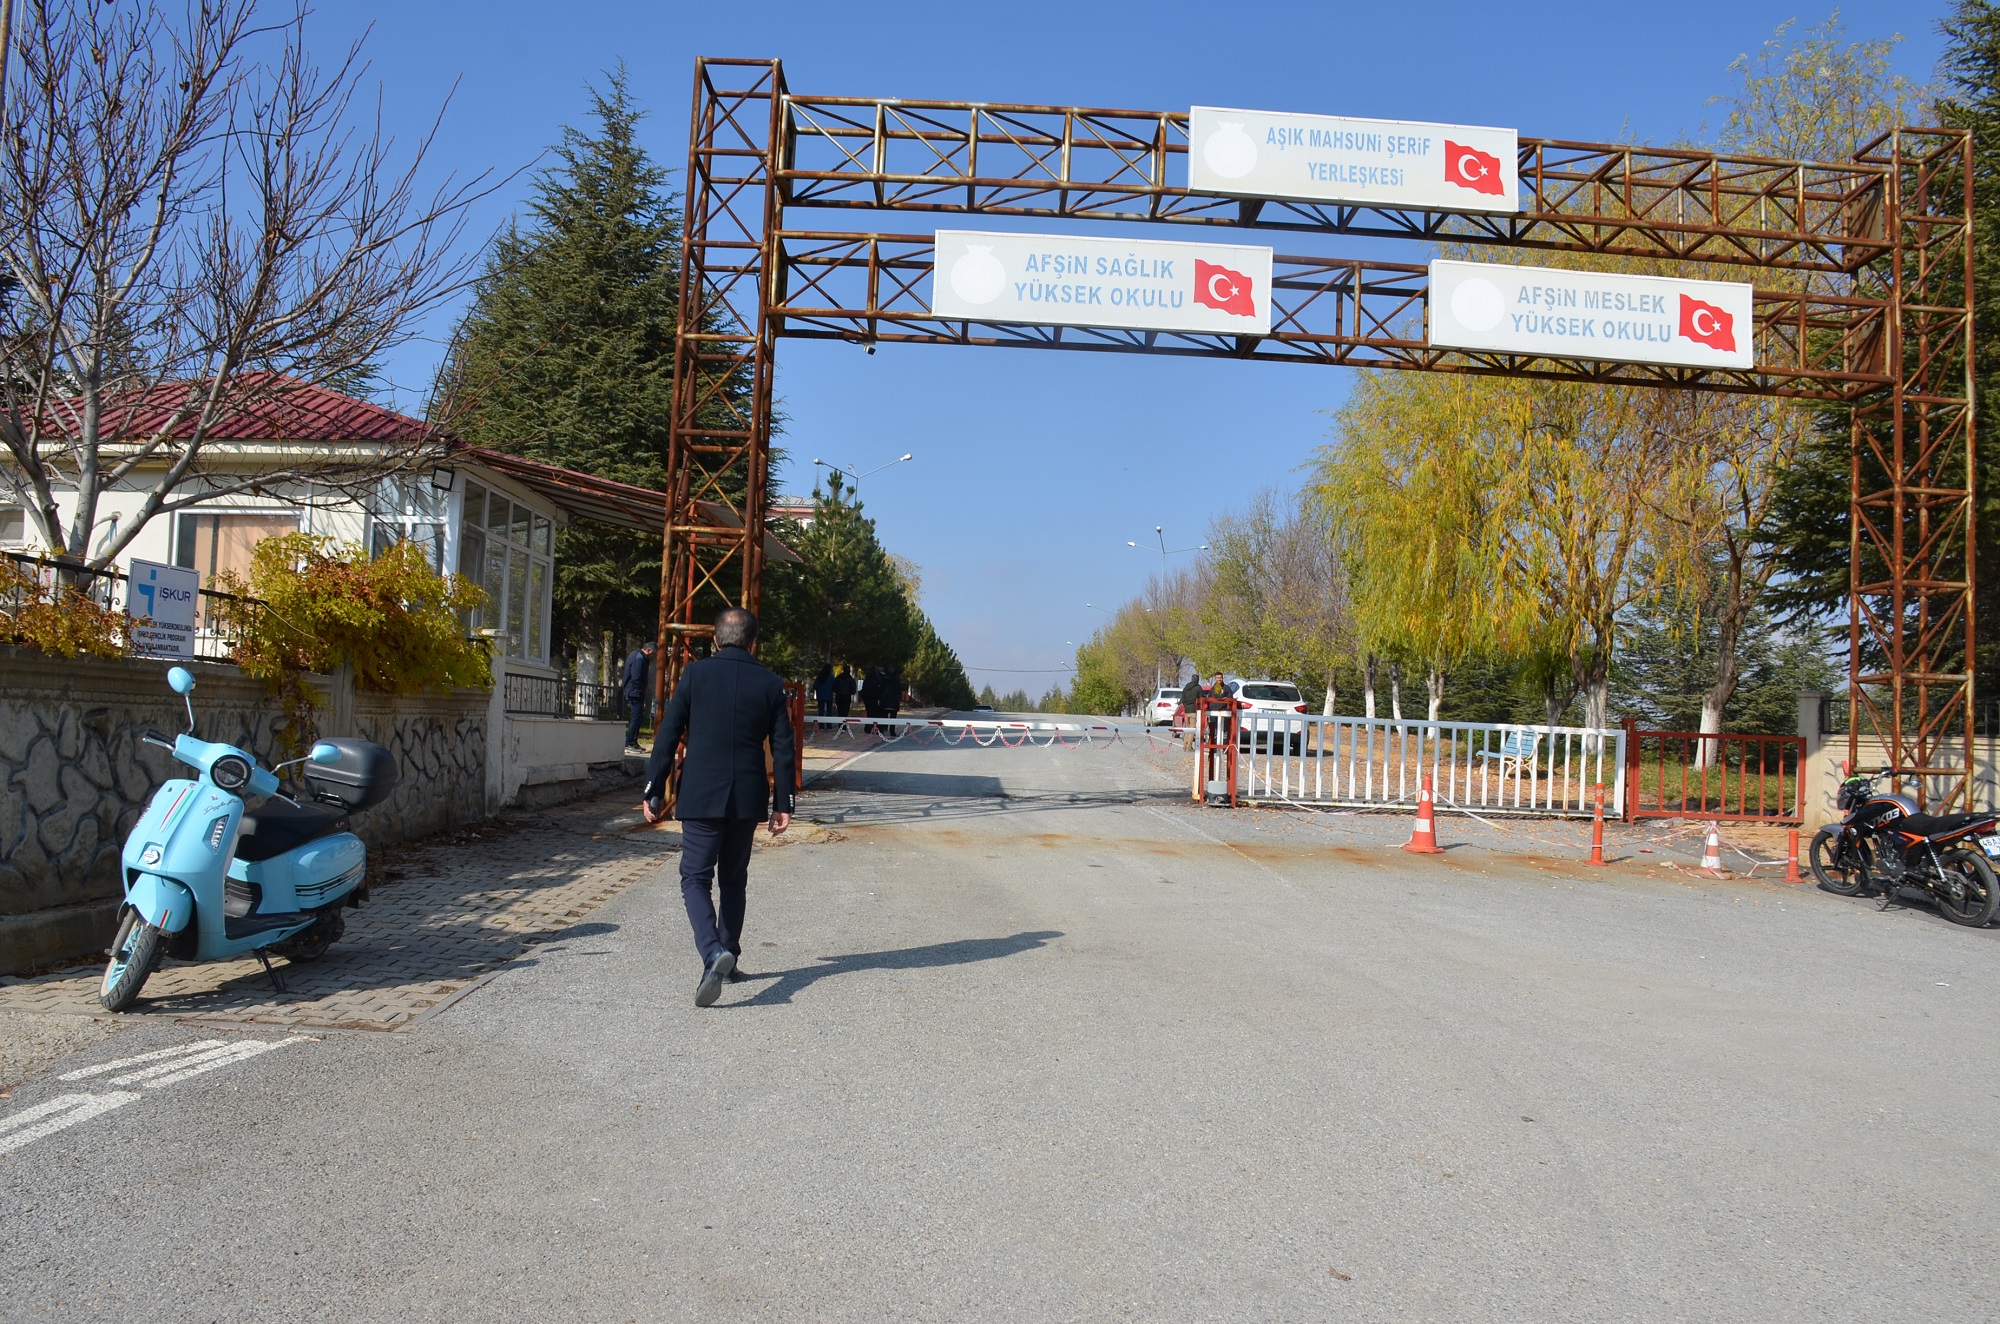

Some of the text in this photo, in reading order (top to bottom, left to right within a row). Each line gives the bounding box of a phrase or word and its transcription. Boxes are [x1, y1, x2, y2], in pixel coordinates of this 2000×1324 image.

[1266, 126, 1304, 150] AŞIK
[1095, 252, 1174, 280] SAĞLIK
[1014, 277, 1184, 309] YÜKSEK OKULU
[1584, 289, 1665, 314] MESLEK
[1511, 308, 1671, 344] YÜKSEK OKULU
